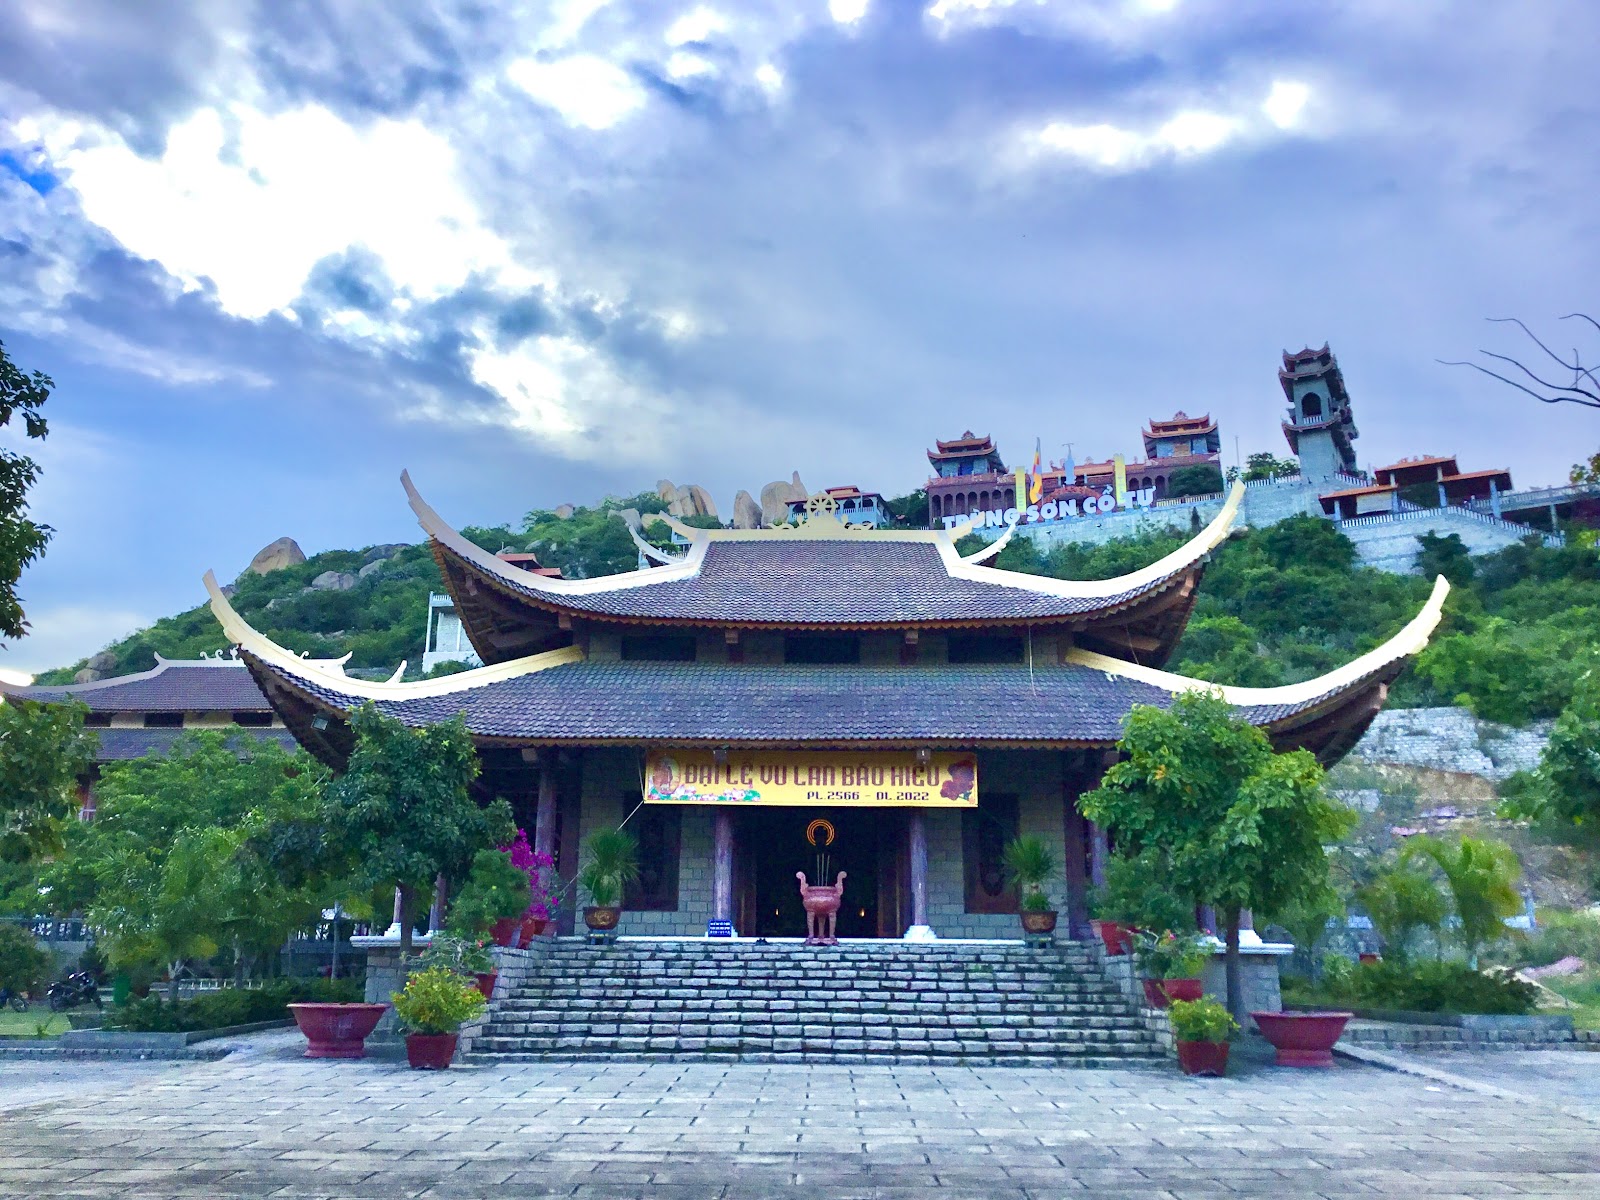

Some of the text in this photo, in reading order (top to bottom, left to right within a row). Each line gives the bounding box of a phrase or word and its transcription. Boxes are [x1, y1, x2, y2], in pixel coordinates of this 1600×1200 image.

[1026, 498, 1077, 522] SƠN
[1082, 484, 1116, 514] CỔ
[1121, 485, 1157, 513] TỰ
[684, 763, 720, 787] ĐẠI
[759, 765, 788, 786] VU
[793, 765, 836, 787] LAN
[841, 761, 885, 787] BÁO
[806, 790, 861, 801] PL.2566
[876, 791, 930, 801] DL.2022
